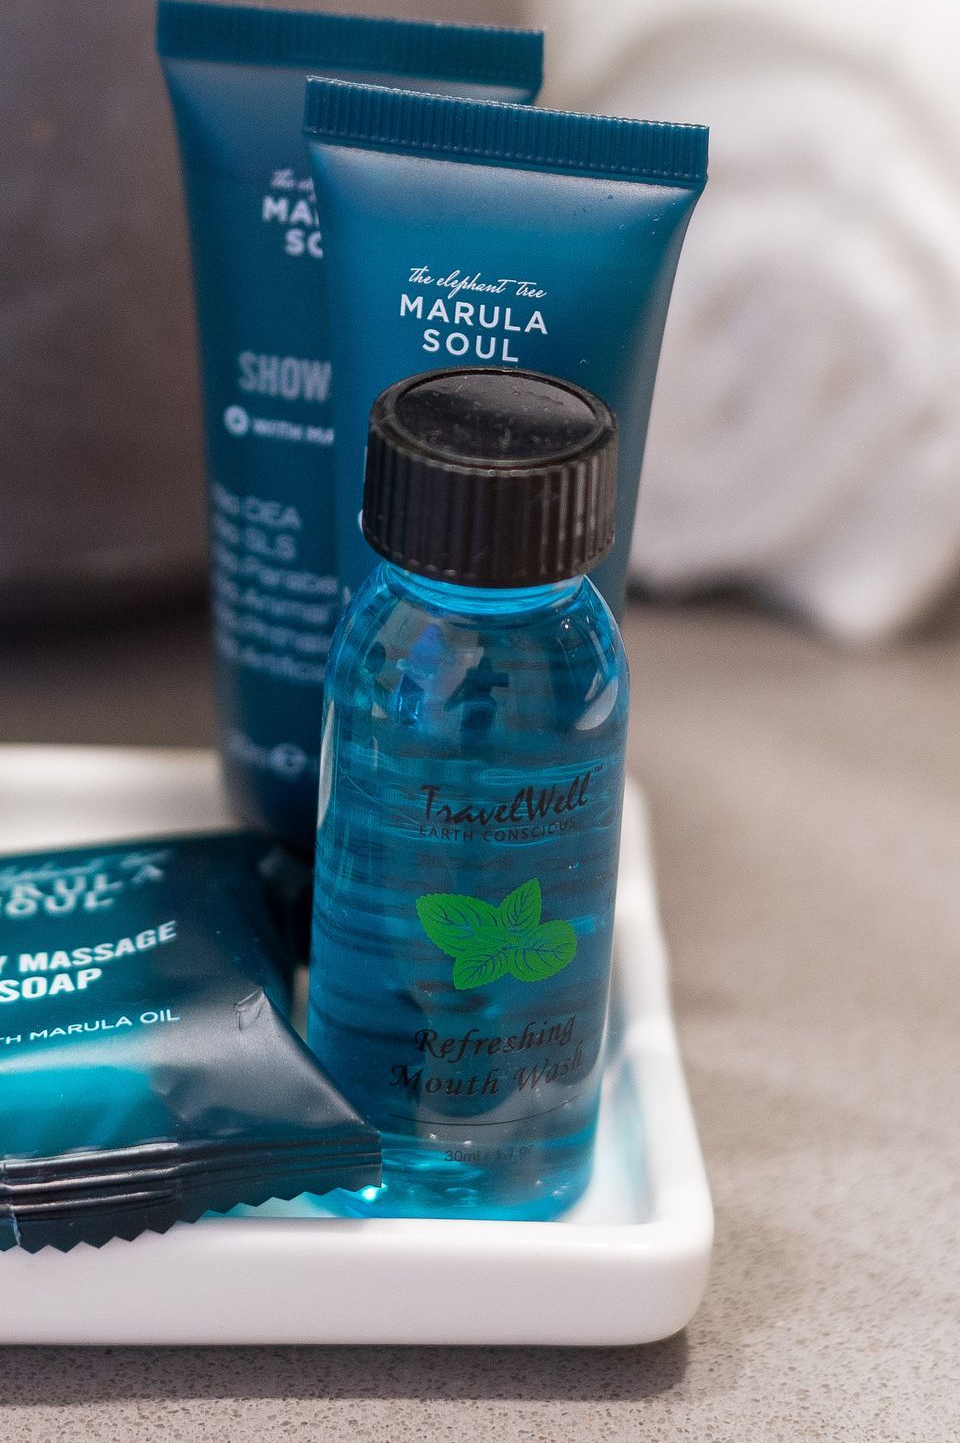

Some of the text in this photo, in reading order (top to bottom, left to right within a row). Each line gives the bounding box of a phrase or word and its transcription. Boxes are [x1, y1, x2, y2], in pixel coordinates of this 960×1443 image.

[261, 195, 320, 226] MA
[408, 265, 435, 285] the
[436, 269, 517, 299] elephant
[399, 293, 548, 335] MARULA
[422, 328, 519, 363] SOUL
[239, 351, 332, 402] SHOW
[420, 771, 592, 826] TravelWell
[419, 817, 576, 842] EARTH CONSCIOUS
[19, 920, 178, 973] MASSAGE
[29, 1015, 133, 1041] MARULA
[140, 1008, 180, 1024] OIL
[414, 1015, 577, 1064] Refreshing
[388, 1039, 584, 1097] Mouth Wash
